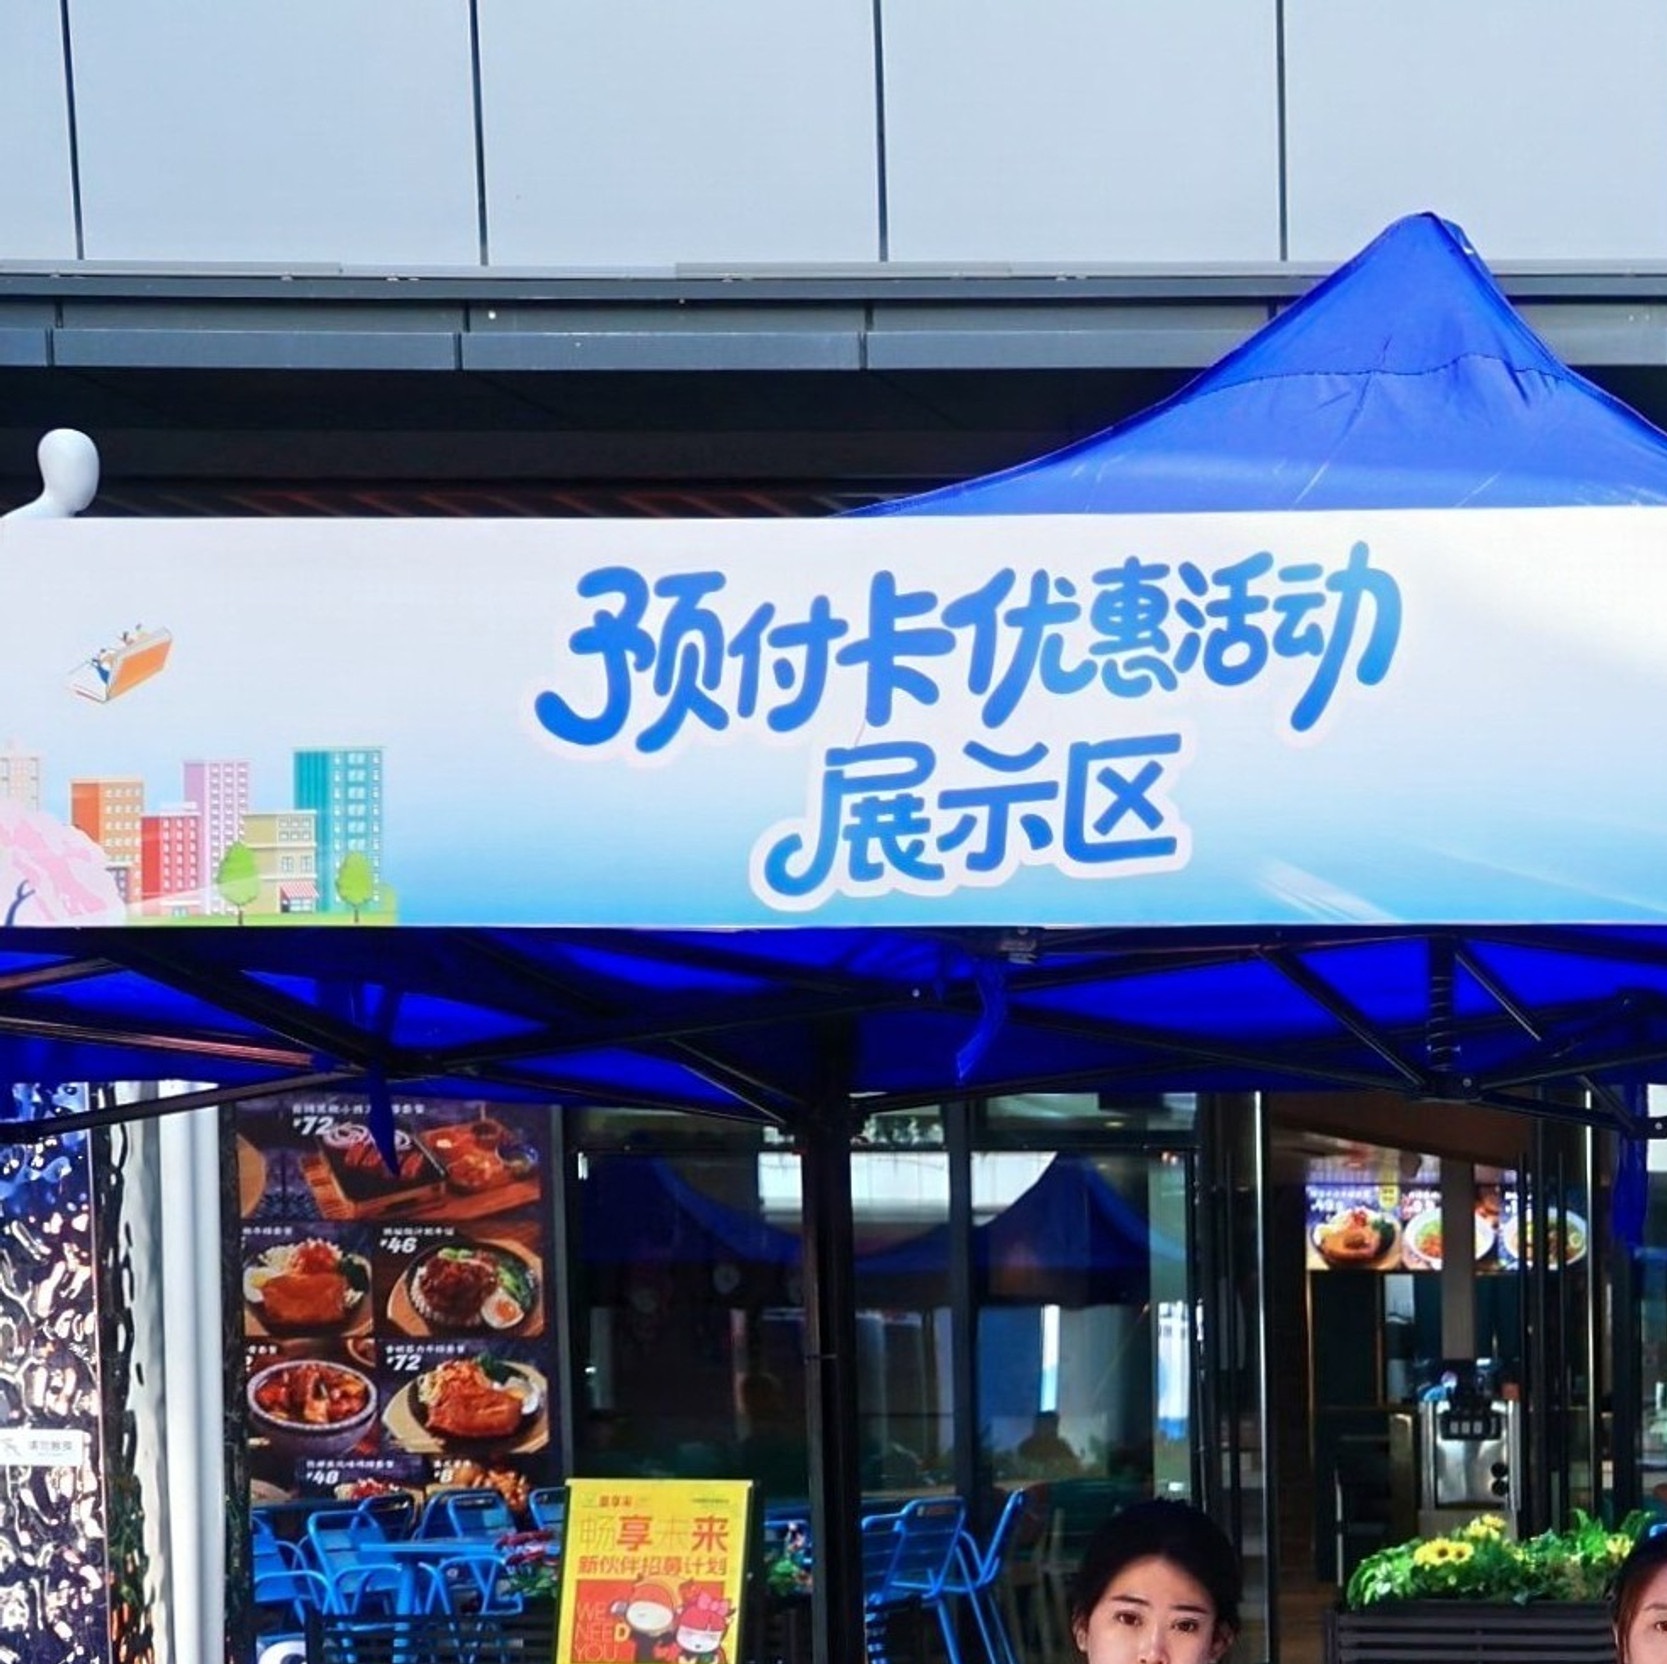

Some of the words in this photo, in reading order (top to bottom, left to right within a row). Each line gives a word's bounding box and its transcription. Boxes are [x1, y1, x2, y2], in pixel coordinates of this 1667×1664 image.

[534, 541, 1403, 755] 预付卡优惠活动
[764, 734, 1182, 896] 展示区
[579, 1514, 729, 1553] 畅享未来
[576, 1622, 631, 1642] NEED
